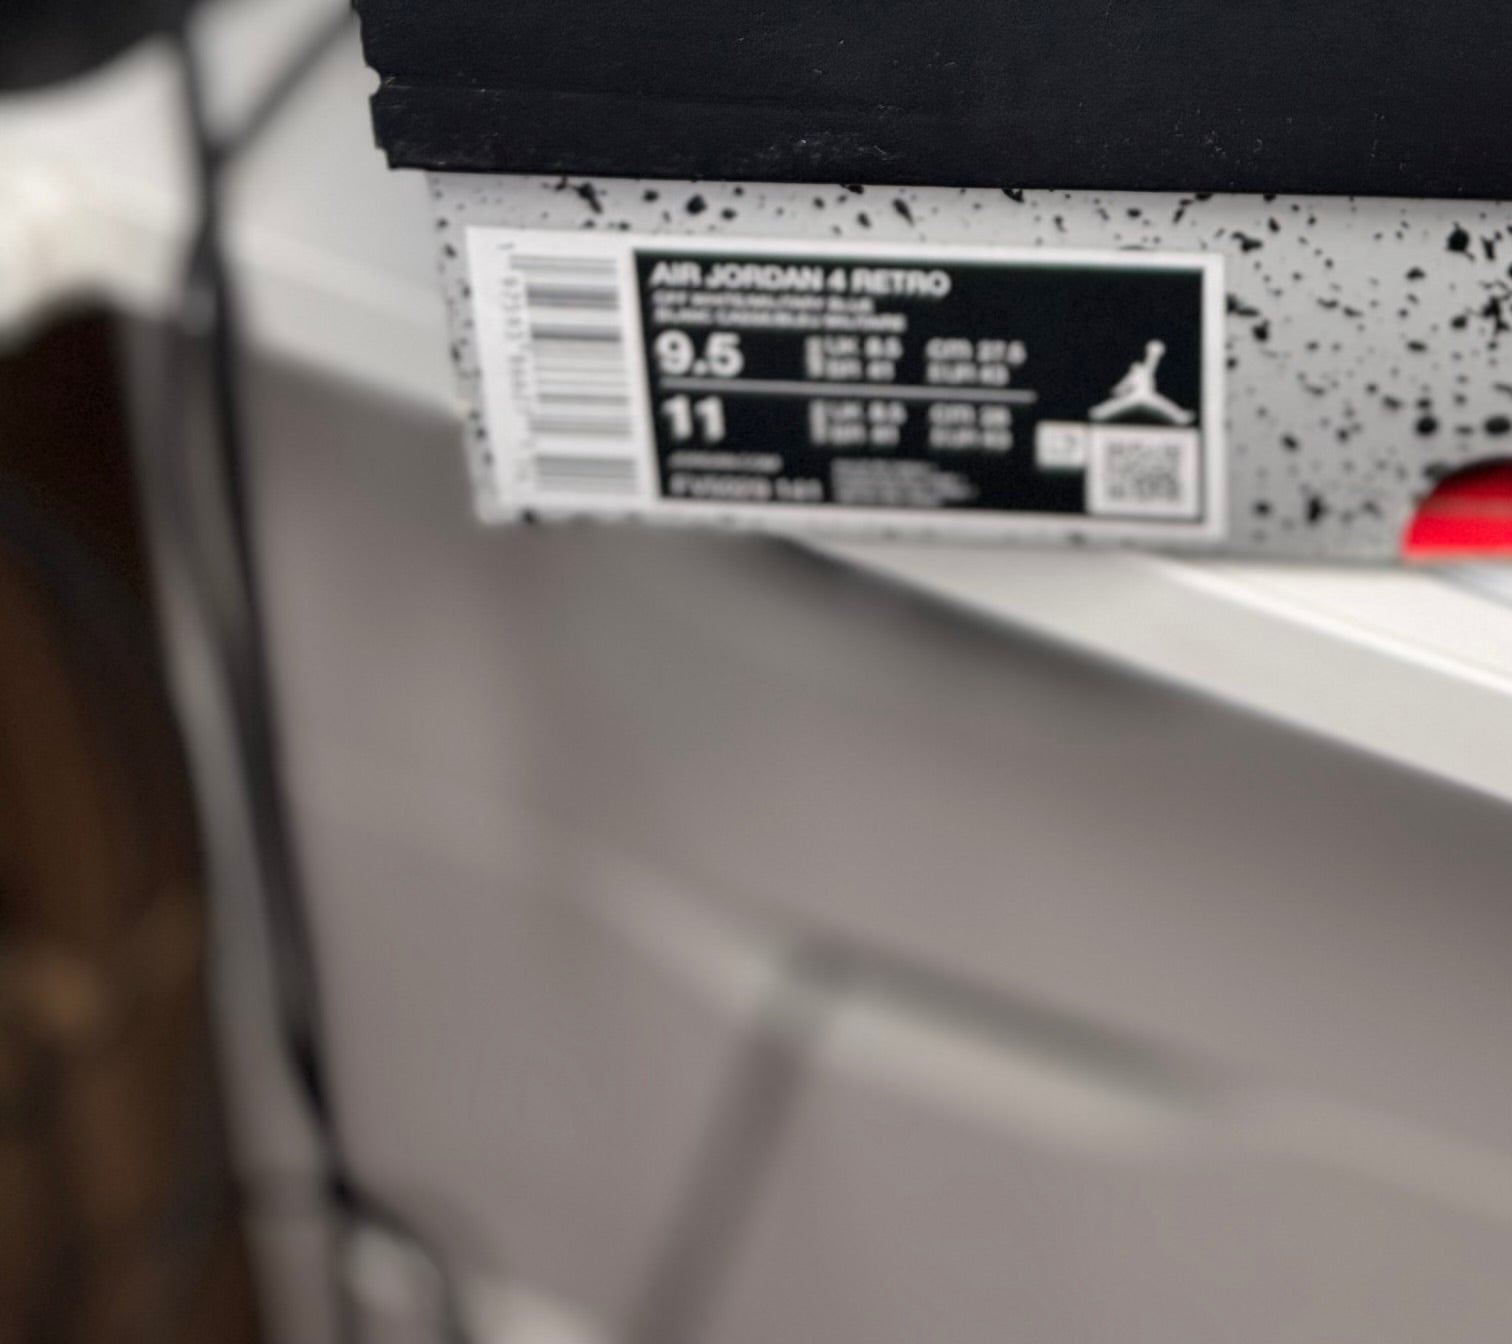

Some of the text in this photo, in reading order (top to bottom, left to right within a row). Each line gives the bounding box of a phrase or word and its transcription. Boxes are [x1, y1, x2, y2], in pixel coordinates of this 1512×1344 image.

[649, 261, 951, 298] AIR JORDAN 4 RETRO
[655, 330, 744, 378] 9.5
[662, 395, 726, 443] 11
